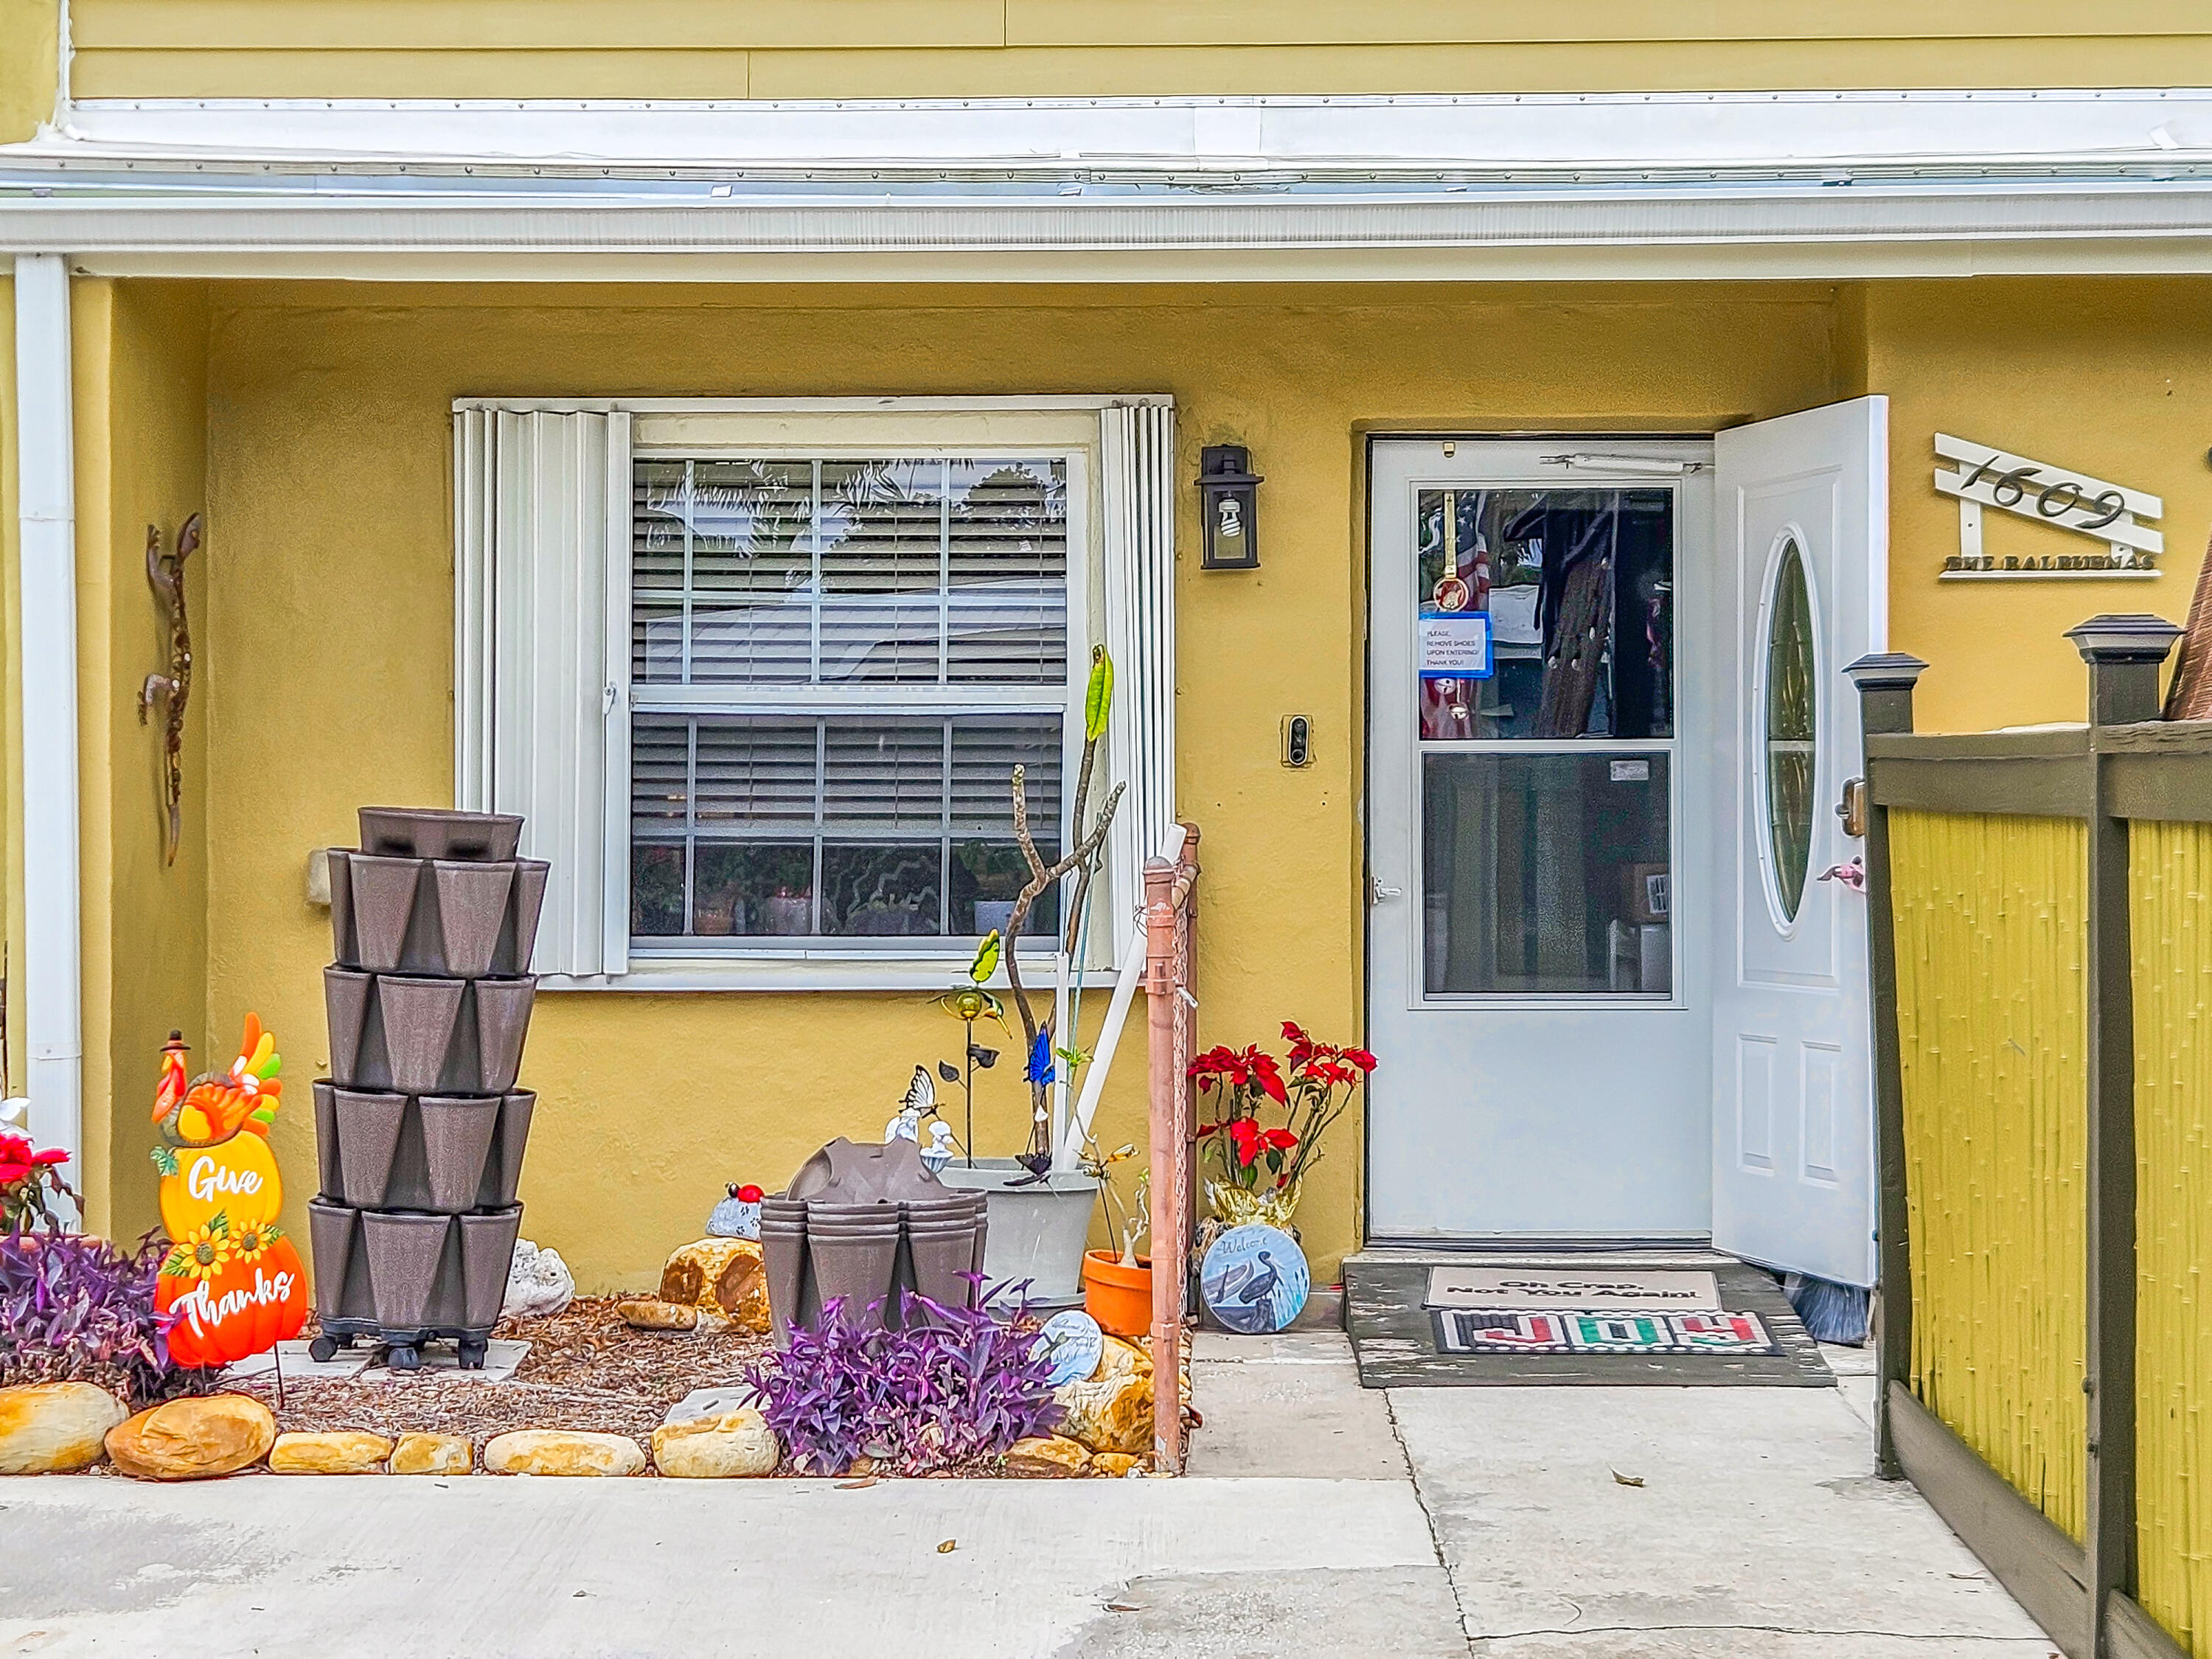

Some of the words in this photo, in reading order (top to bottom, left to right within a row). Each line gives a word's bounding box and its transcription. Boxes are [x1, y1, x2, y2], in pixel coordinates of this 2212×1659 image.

[1960, 455, 2125, 529] 1609
[1945, 555, 1994, 571] THE
[188, 1155, 263, 1202] Give
[1447, 1287, 1509, 1295] Not
[1590, 1290, 1702, 1298] Again!
[1499, 1280, 1549, 1288] Oh
[169, 1267, 296, 1338] Thanks
